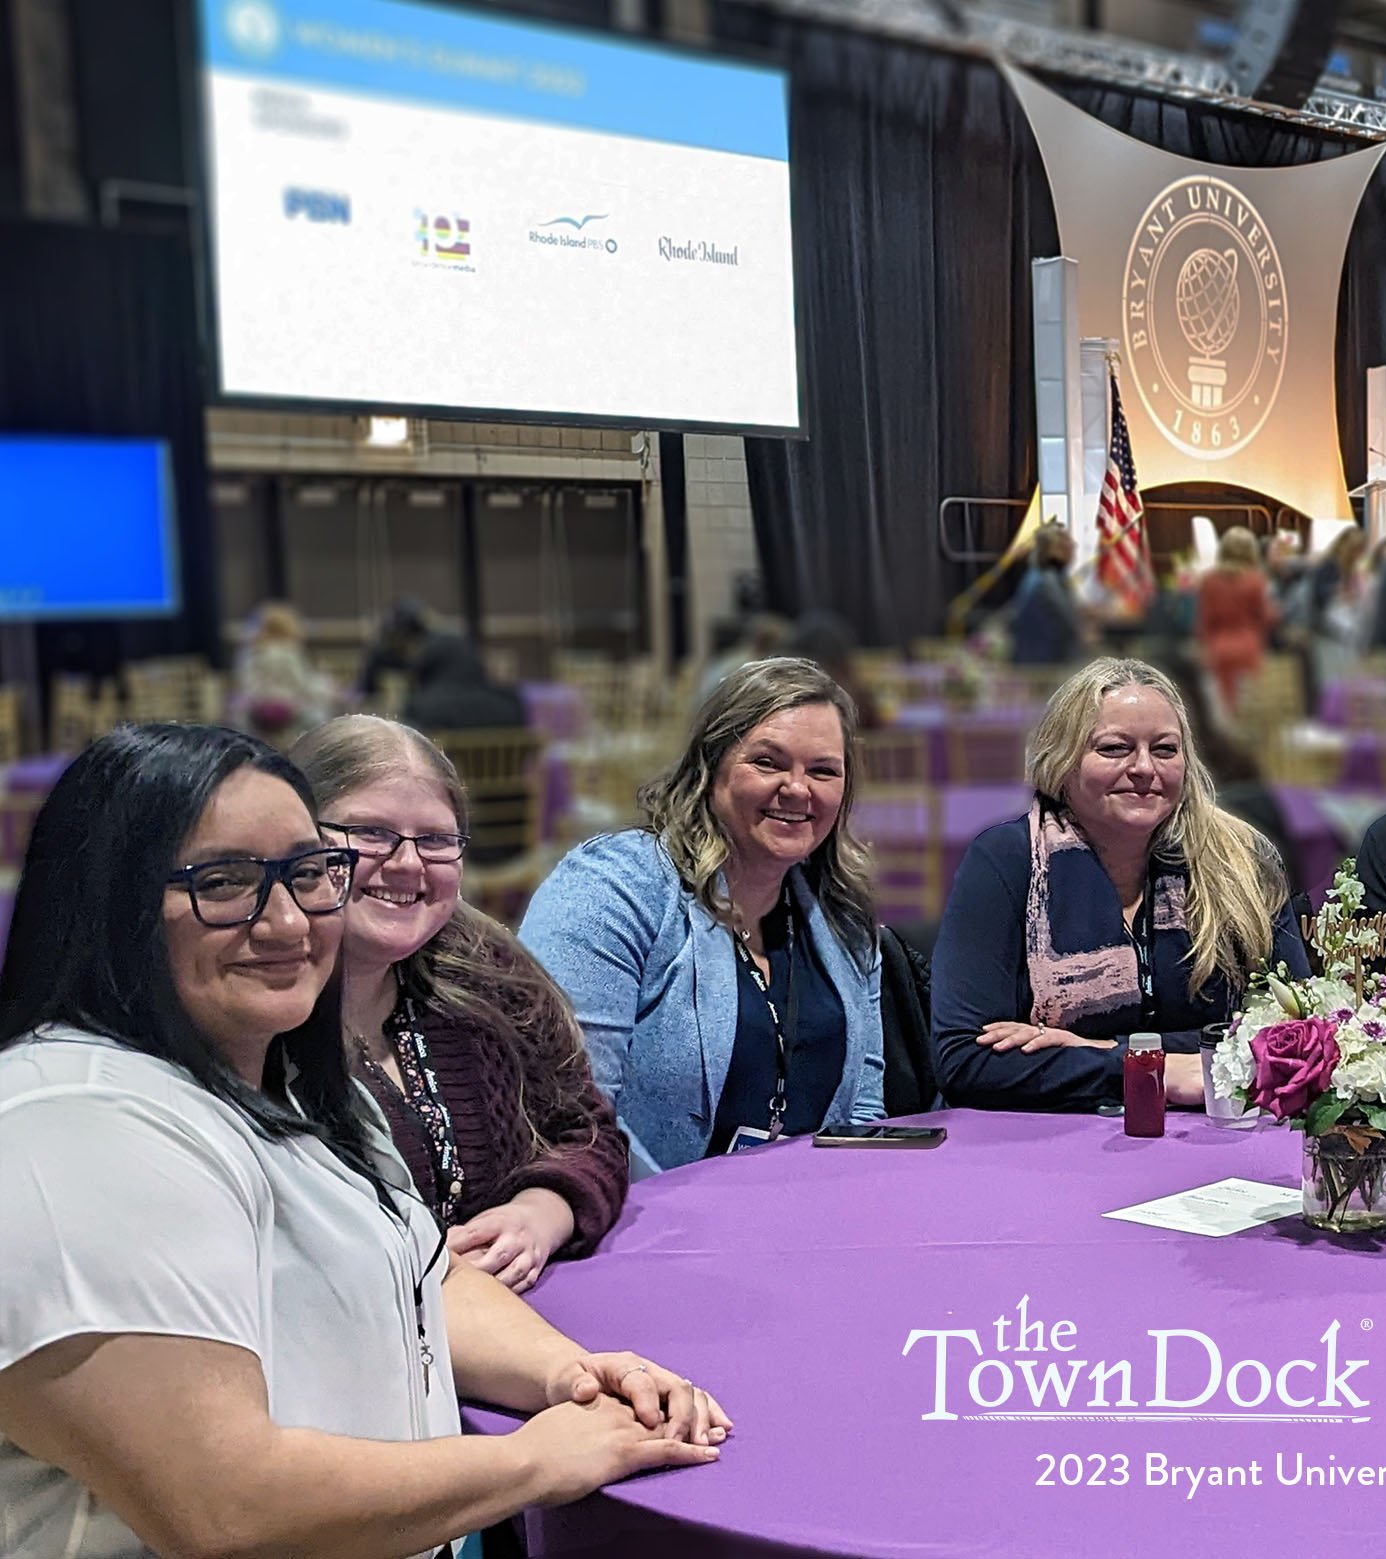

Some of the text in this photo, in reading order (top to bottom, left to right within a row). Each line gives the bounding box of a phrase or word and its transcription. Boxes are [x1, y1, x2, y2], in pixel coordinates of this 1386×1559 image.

[529, 231, 558, 246] Rhode
[560, 235, 587, 249] Island
[658, 236, 739, 266] Rhode Island
[1130, 184, 1284, 366] BRYANT UNIVERSITY
[1171, 409, 1241, 447] 1863
[414, 1033, 427, 1059] Amica
[424, 1068, 438, 1094] Amica
[441, 1141, 453, 1170] Amica
